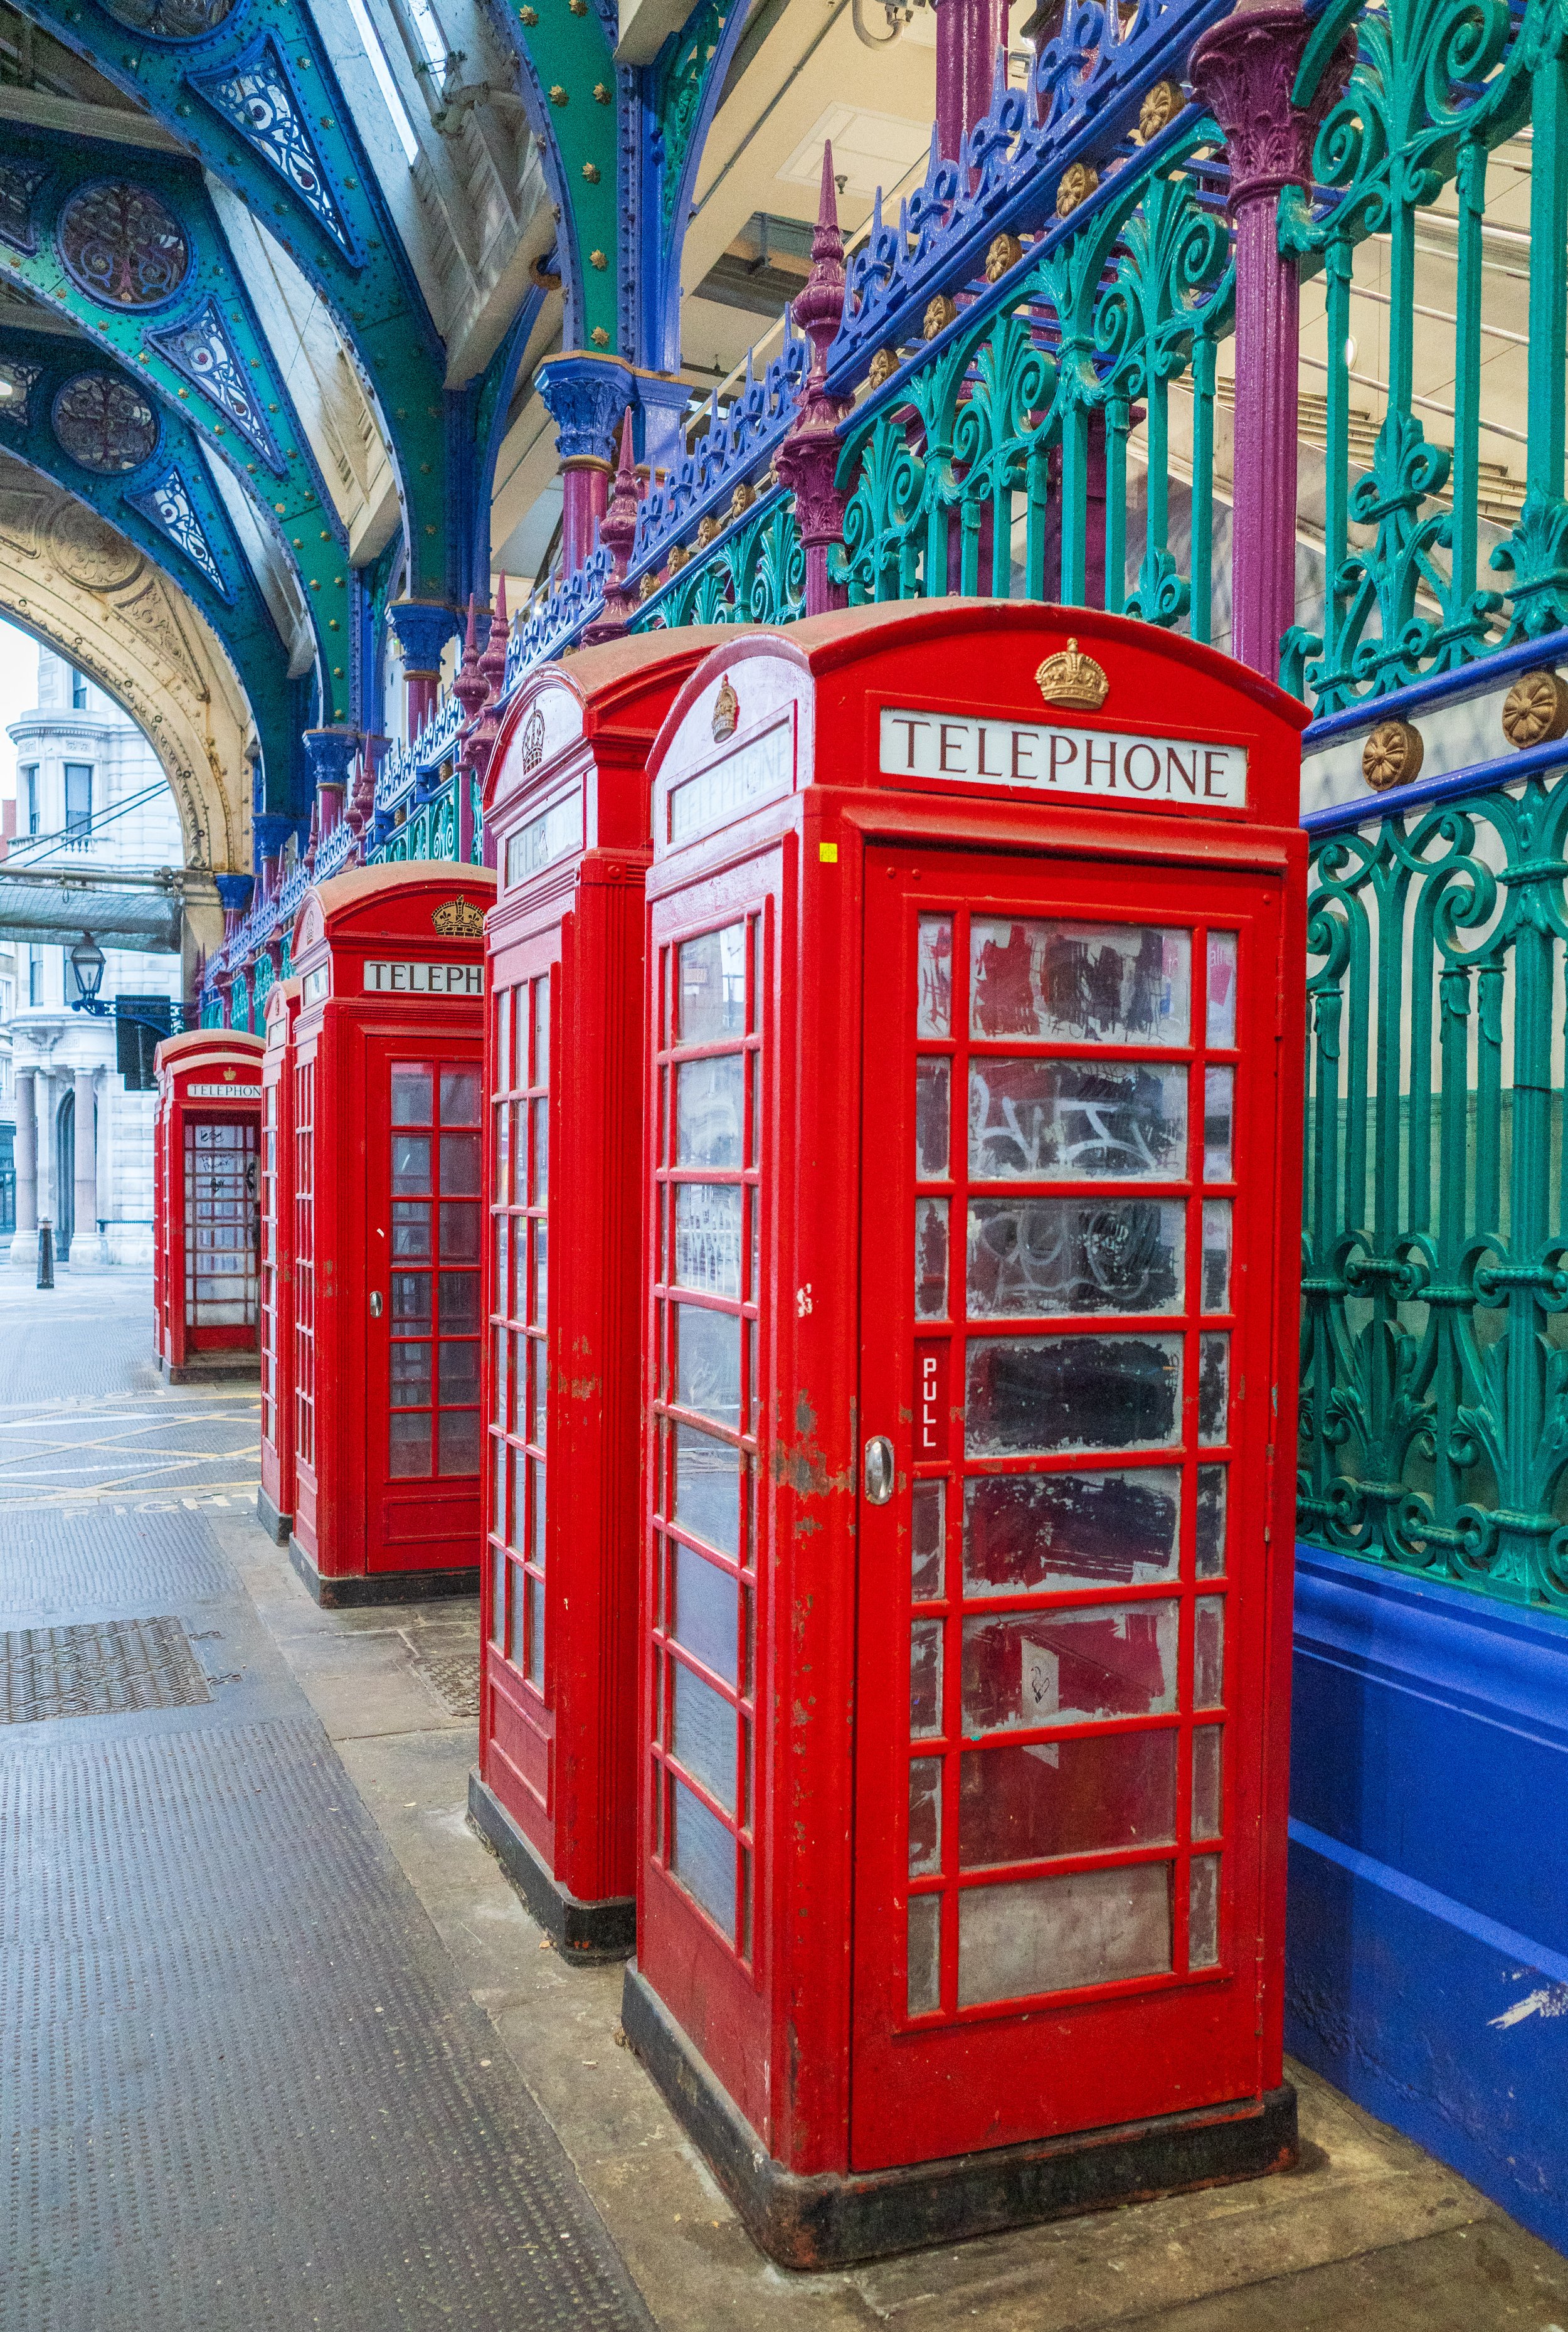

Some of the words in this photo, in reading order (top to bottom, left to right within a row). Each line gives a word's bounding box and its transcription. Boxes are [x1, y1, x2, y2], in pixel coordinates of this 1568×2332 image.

[675, 729, 787, 831] TELEPHONE
[892, 718, 1229, 798] TELEPHONE
[369, 963, 482, 993] TELEPH
[191, 1084, 261, 1096] TELEPHON
[923, 1357, 936, 1447] PULL
